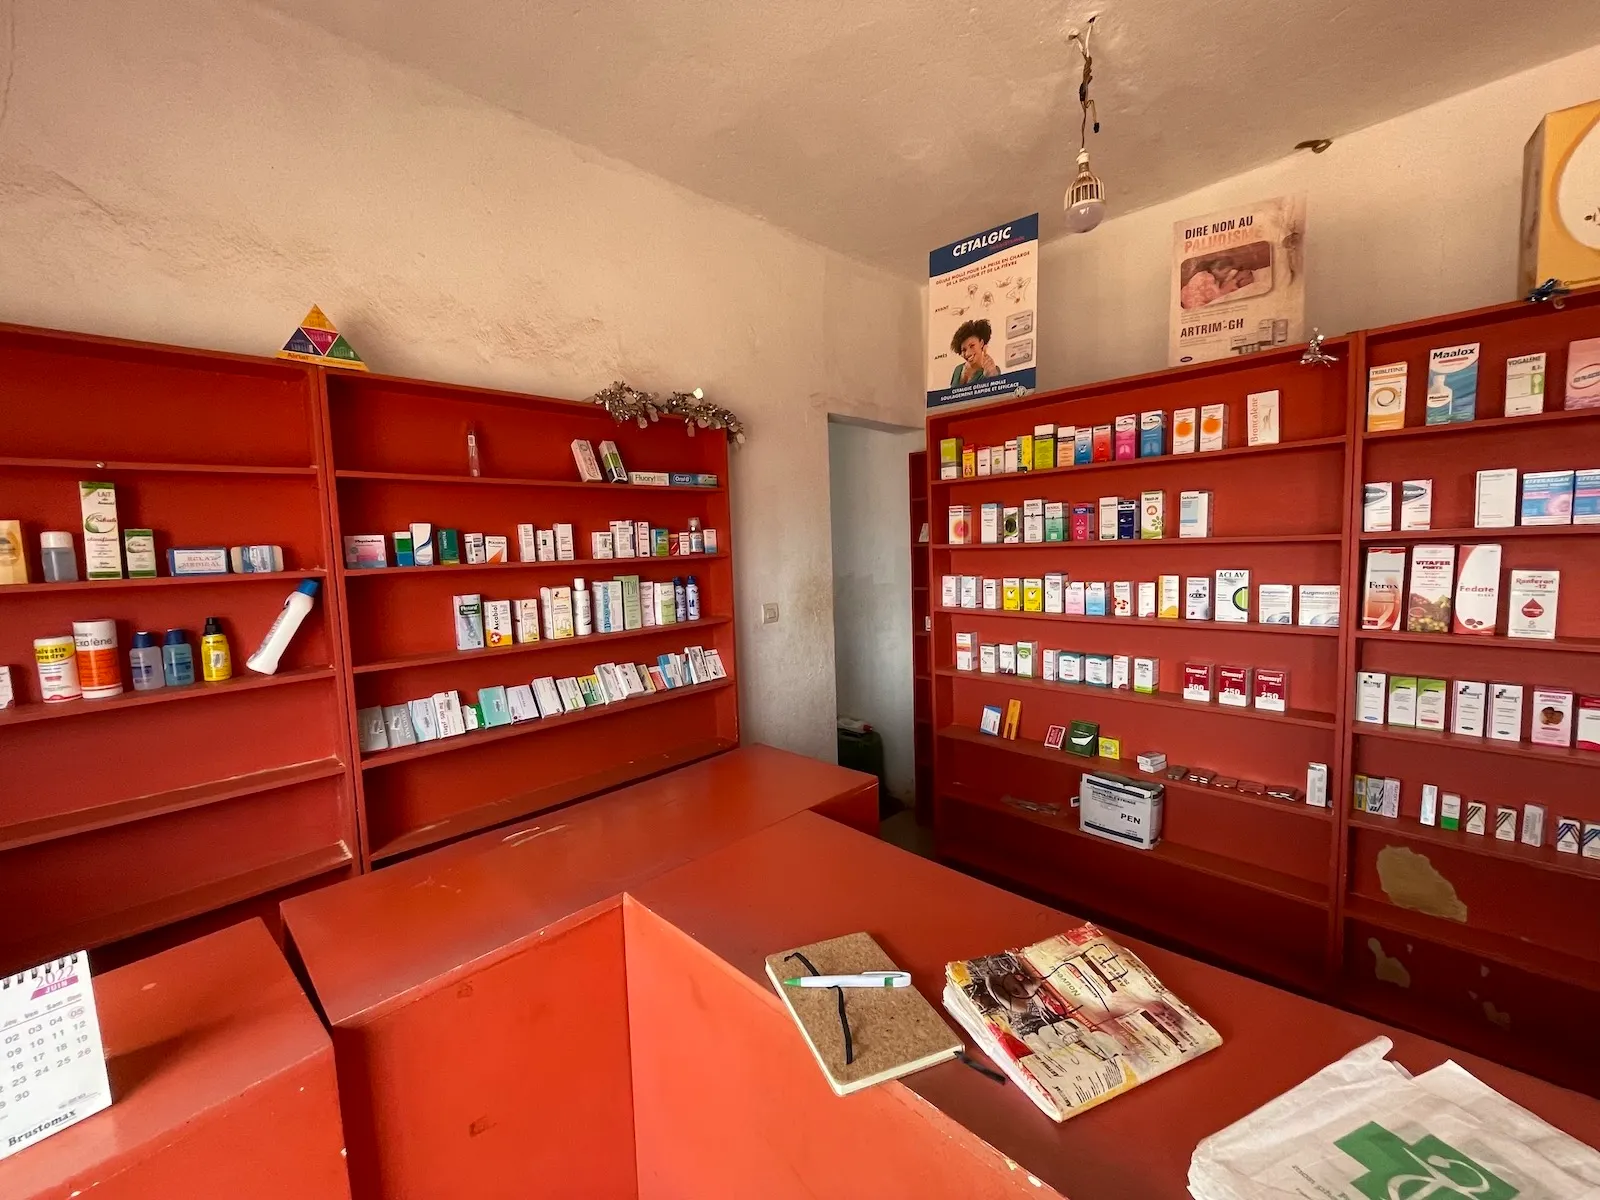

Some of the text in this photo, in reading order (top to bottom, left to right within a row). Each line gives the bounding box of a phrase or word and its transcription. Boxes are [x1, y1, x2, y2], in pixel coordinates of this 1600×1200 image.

[1185, 215, 1254, 240] DIRE NON AU
[952, 226, 1012, 257] CETALGIC
[1184, 227, 1263, 253] PALUDISME
[1432, 347, 1475, 360] Maalox
[1372, 366, 1404, 376] TRIBUTINE
[1218, 571, 1246, 579] ACLAV
[1369, 581, 1398, 589] Ferox
[1460, 585, 1494, 593] Fedate
[1224, 687, 1240, 695] 250
[1261, 692, 1279, 700] 250
[1121, 813, 1141, 824] PEN
[36, 965, 75, 989] 2022
[1049, 966, 1080, 996] Nouveau
[45, 980, 68, 994] JUIN
[5, 1008, 83, 1044] 02 03 04 05
[6, 1021, 86, 1058] 09 10 11 12
[11, 1034, 88, 1072] 16 17 18 19
[12, 1048, 91, 1087] 23 24 25 26
[15, 1090, 30, 1102] 30
[8, 1109, 76, 1146] Brustomax
